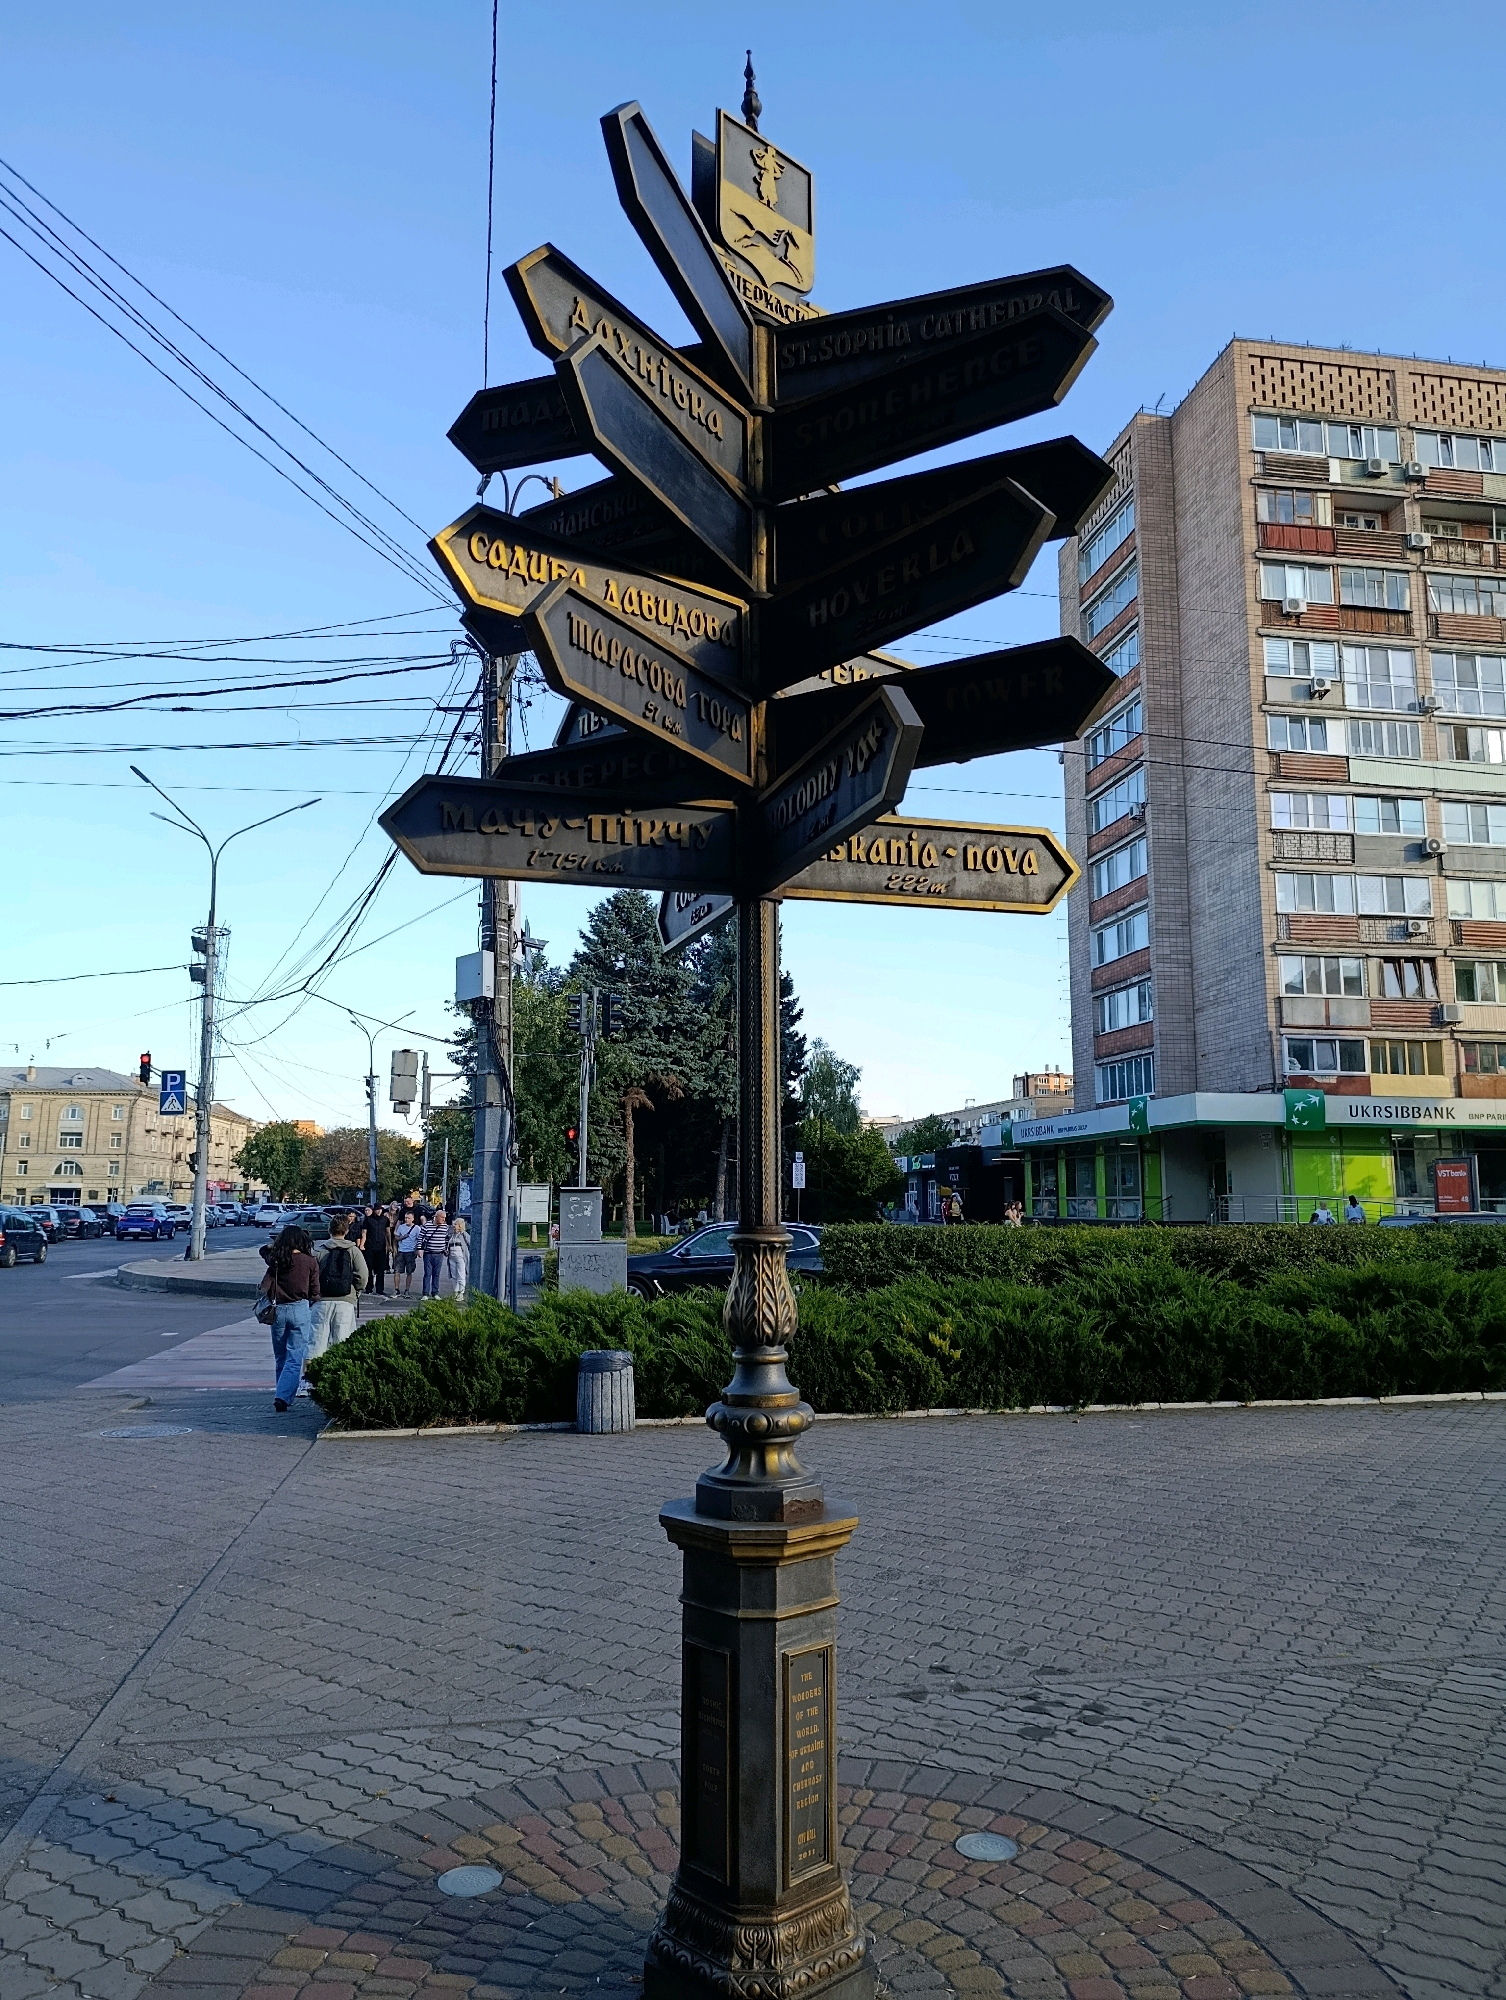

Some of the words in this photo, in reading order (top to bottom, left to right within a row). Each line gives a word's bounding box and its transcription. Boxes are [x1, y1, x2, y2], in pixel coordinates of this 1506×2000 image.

[807, 528, 975, 628] HOVERLA
[167, 1074, 180, 1091] P
[1349, 1105, 1456, 1120] UKRSIBBANK
[1020, 1124, 1055, 1139] UKRSIBBANK
[801, 1671, 813, 1683] THE
[795, 1710, 804, 1721] OF
[806, 1705, 819, 1717] THE
[801, 1760, 815, 1773] AND
[798, 1848, 816, 1861] 2011
